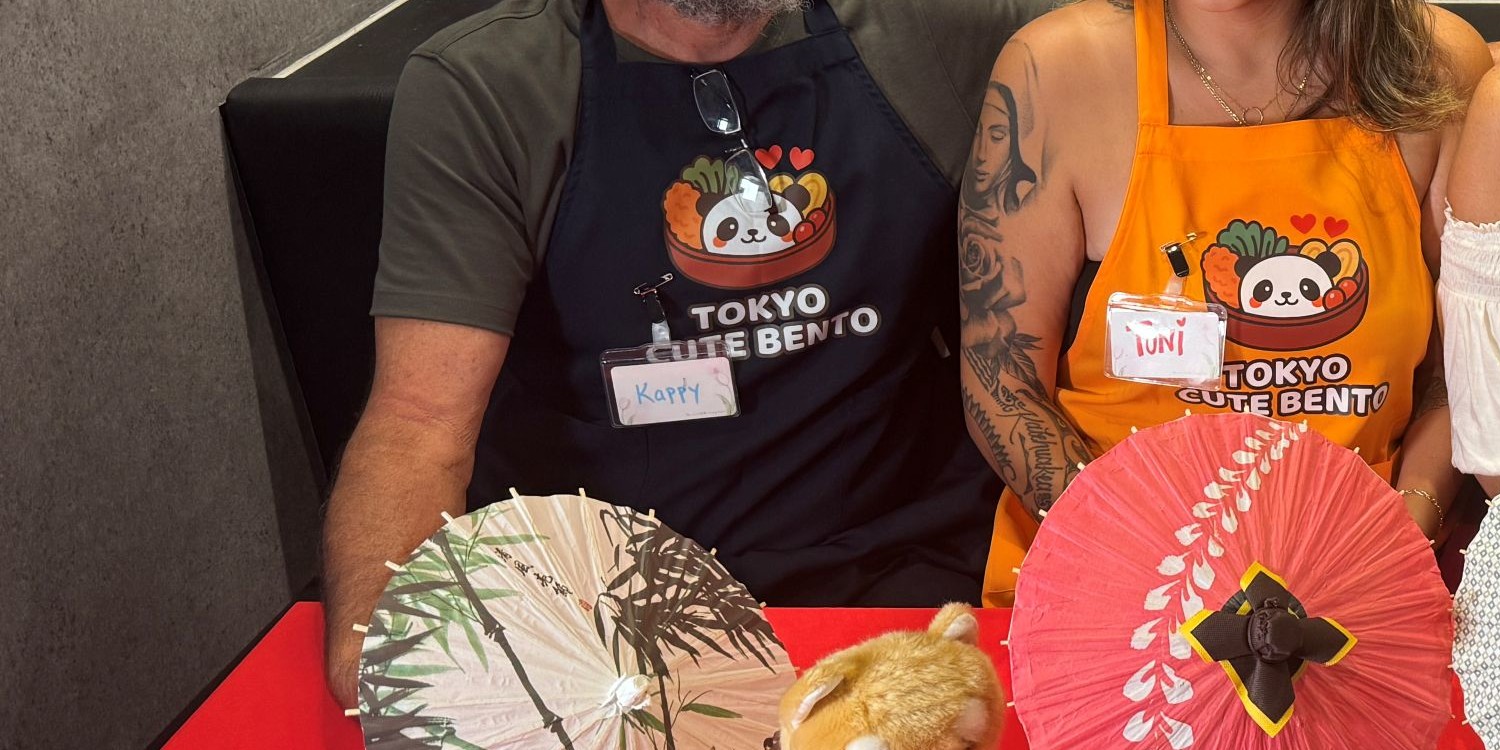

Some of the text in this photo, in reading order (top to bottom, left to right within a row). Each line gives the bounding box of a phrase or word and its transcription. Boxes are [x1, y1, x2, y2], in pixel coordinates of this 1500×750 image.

[691, 287, 826, 330] TOKYO
[645, 307, 878, 362] CUTE BENTO
[1223, 356, 1348, 388] TOKYO
[636, 380, 700, 405] Kappy
[1178, 385, 1388, 416] CUTE BENTO
